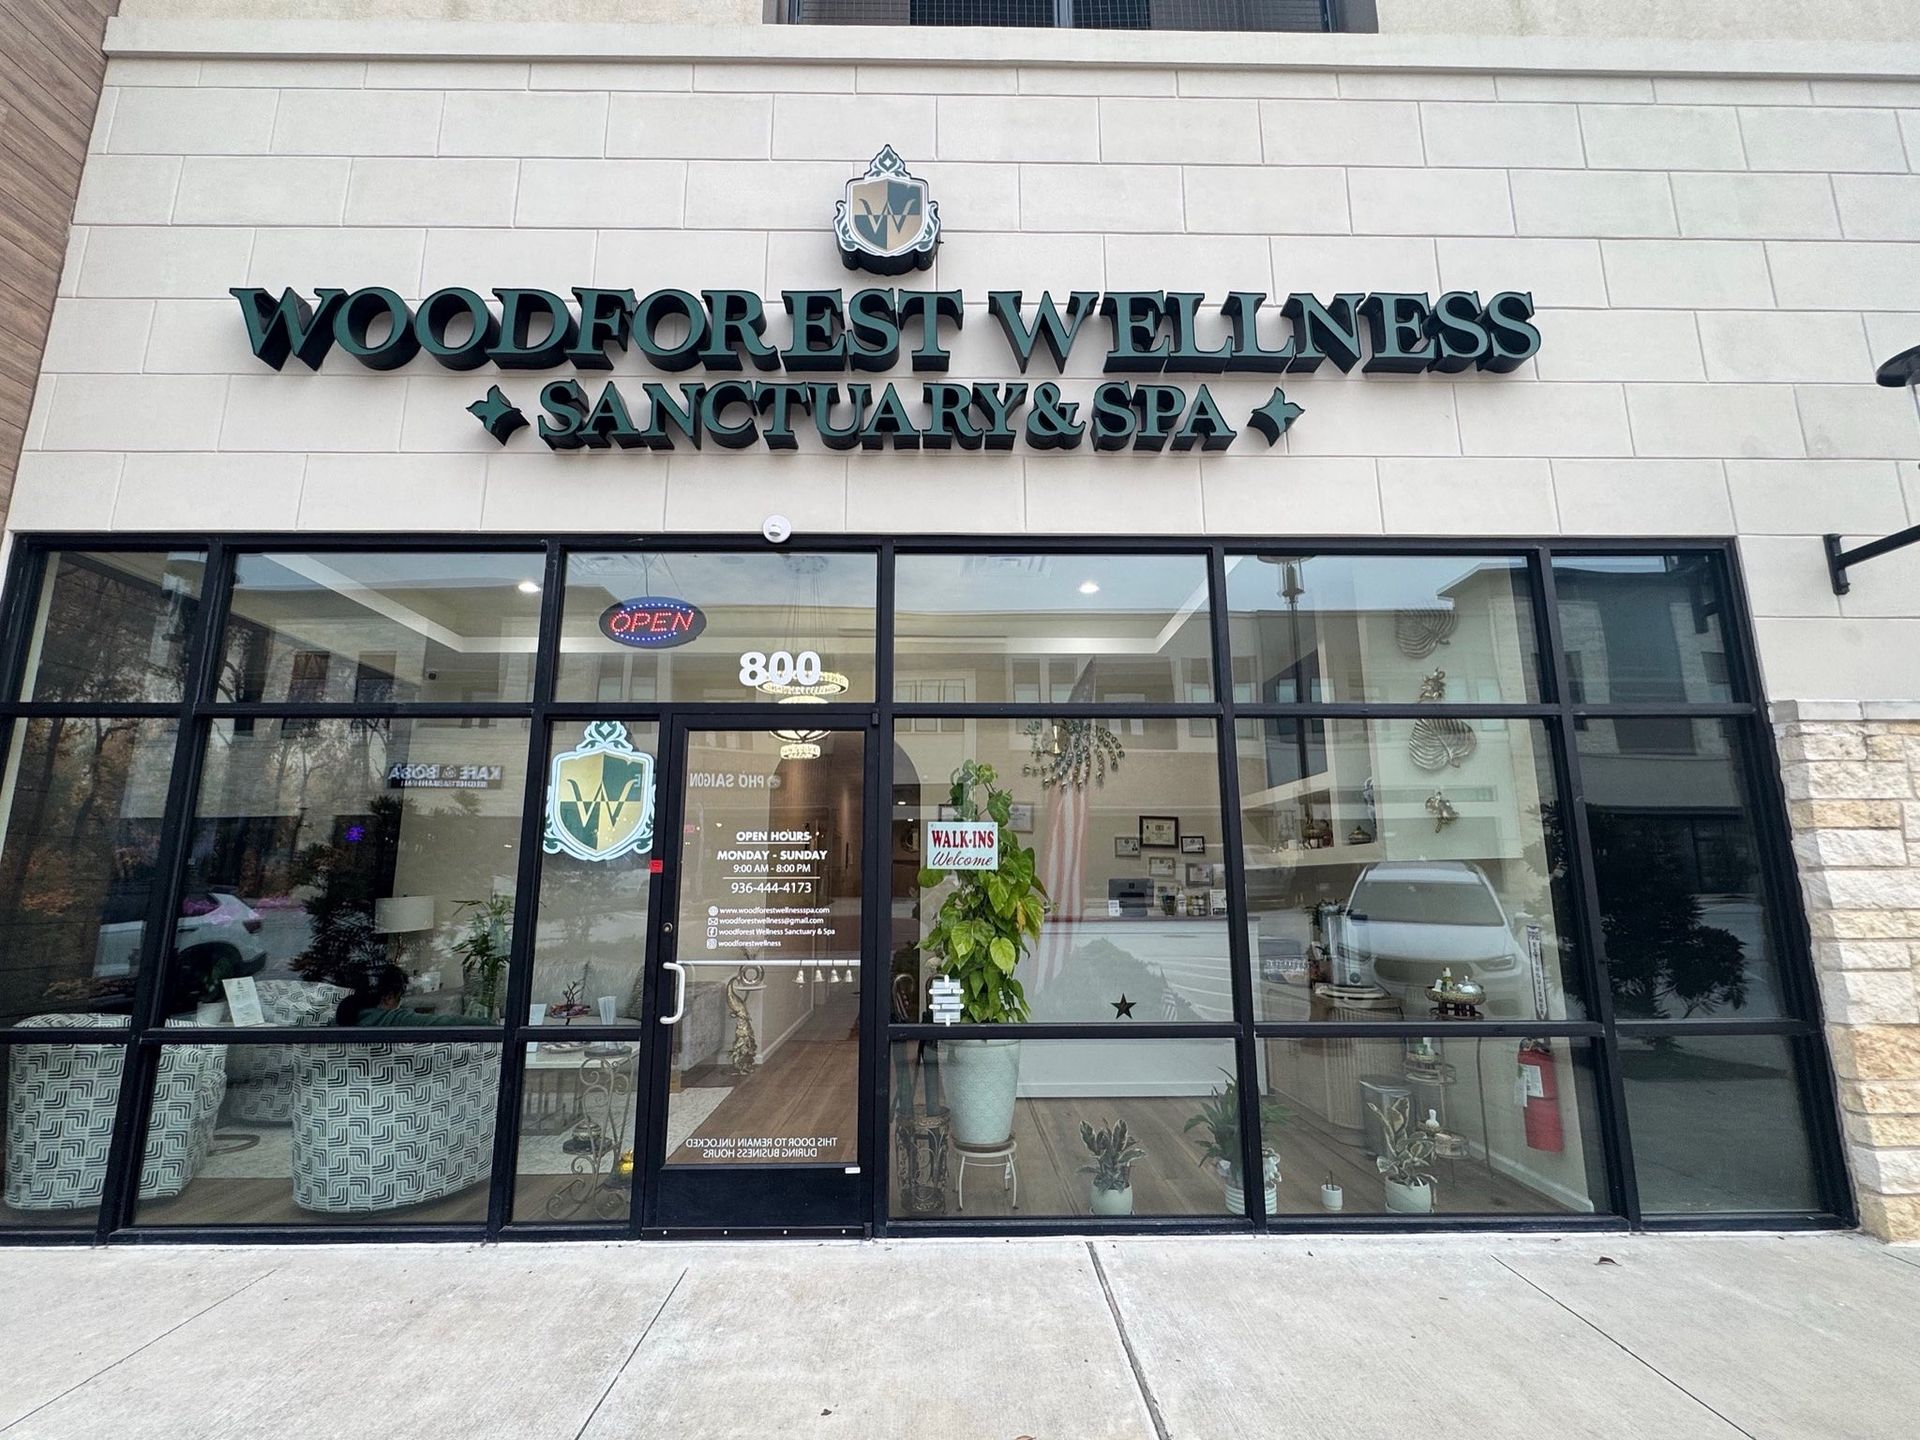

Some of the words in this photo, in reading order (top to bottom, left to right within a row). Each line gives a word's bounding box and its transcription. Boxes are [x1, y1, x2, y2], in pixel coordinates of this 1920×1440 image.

[230, 286, 963, 371] WOODFOREST
[988, 290, 1542, 373] WELLNESS
[609, 611, 696, 634] OPEN
[739, 650, 823, 687] 800
[736, 831, 768, 842] OPEN
[770, 831, 811, 842] HOURS
[932, 830, 995, 849] WALK-INS
[716, 850, 770, 861] MONDAY
[780, 850, 828, 861] SUNDAY
[932, 851, 994, 867] Welcome
[733, 864, 753, 873] 9:00
[753, 864, 769, 873] AM
[776, 864, 795, 873] 8:00
[796, 864, 811, 873] PM
[731, 882, 812, 894] 936-444-4173
[719, 917, 824, 925] woodforestwellness@gmail.com
[784, 928, 817, 937] Sanctuary
[823, 928, 836, 937] Spa
